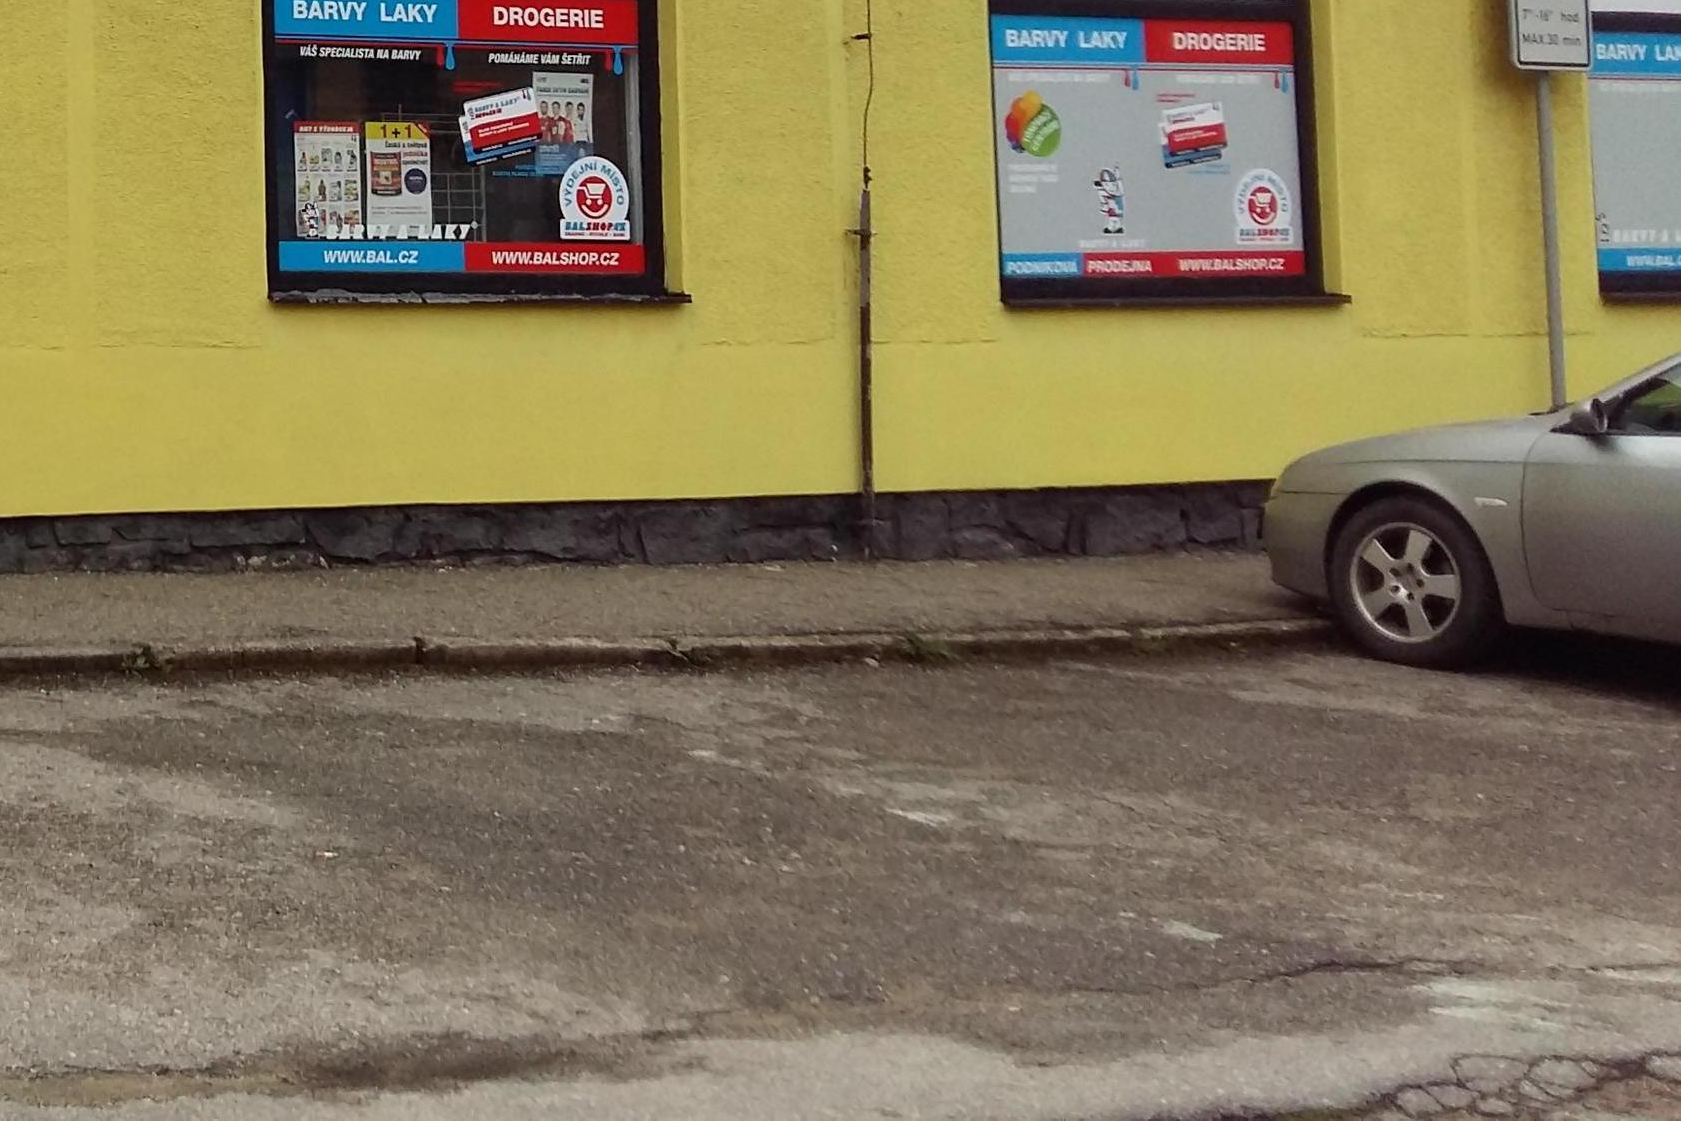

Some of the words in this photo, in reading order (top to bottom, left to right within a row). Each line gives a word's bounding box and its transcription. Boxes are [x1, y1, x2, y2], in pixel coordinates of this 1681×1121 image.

[292, 0, 367, 21] BARVY
[380, 2, 437, 23] LAKY
[492, 6, 604, 28] DROGERIE
[1005, 30, 1068, 48] BARVY
[1078, 31, 1127, 50] LAKY
[1172, 33, 1266, 52] DROGERIE
[299, 45, 318, 57] VÁŠ
[319, 47, 375, 58] SPECIALISTA
[376, 48, 390, 59] NA
[391, 49, 421, 61] BARVY
[488, 52, 539, 64] POMÁHÁME
[540, 53, 560, 64] VÁM
[561, 53, 591, 65] ŠETŘIT
[1596, 43, 1647, 61] BARVY
[323, 250, 419, 264] WWW.BAL.CZ
[491, 251, 619, 265] WWW.BALSHOP.CZ
[1179, 258, 1285, 272] WWW.BALSHOP.CZ
